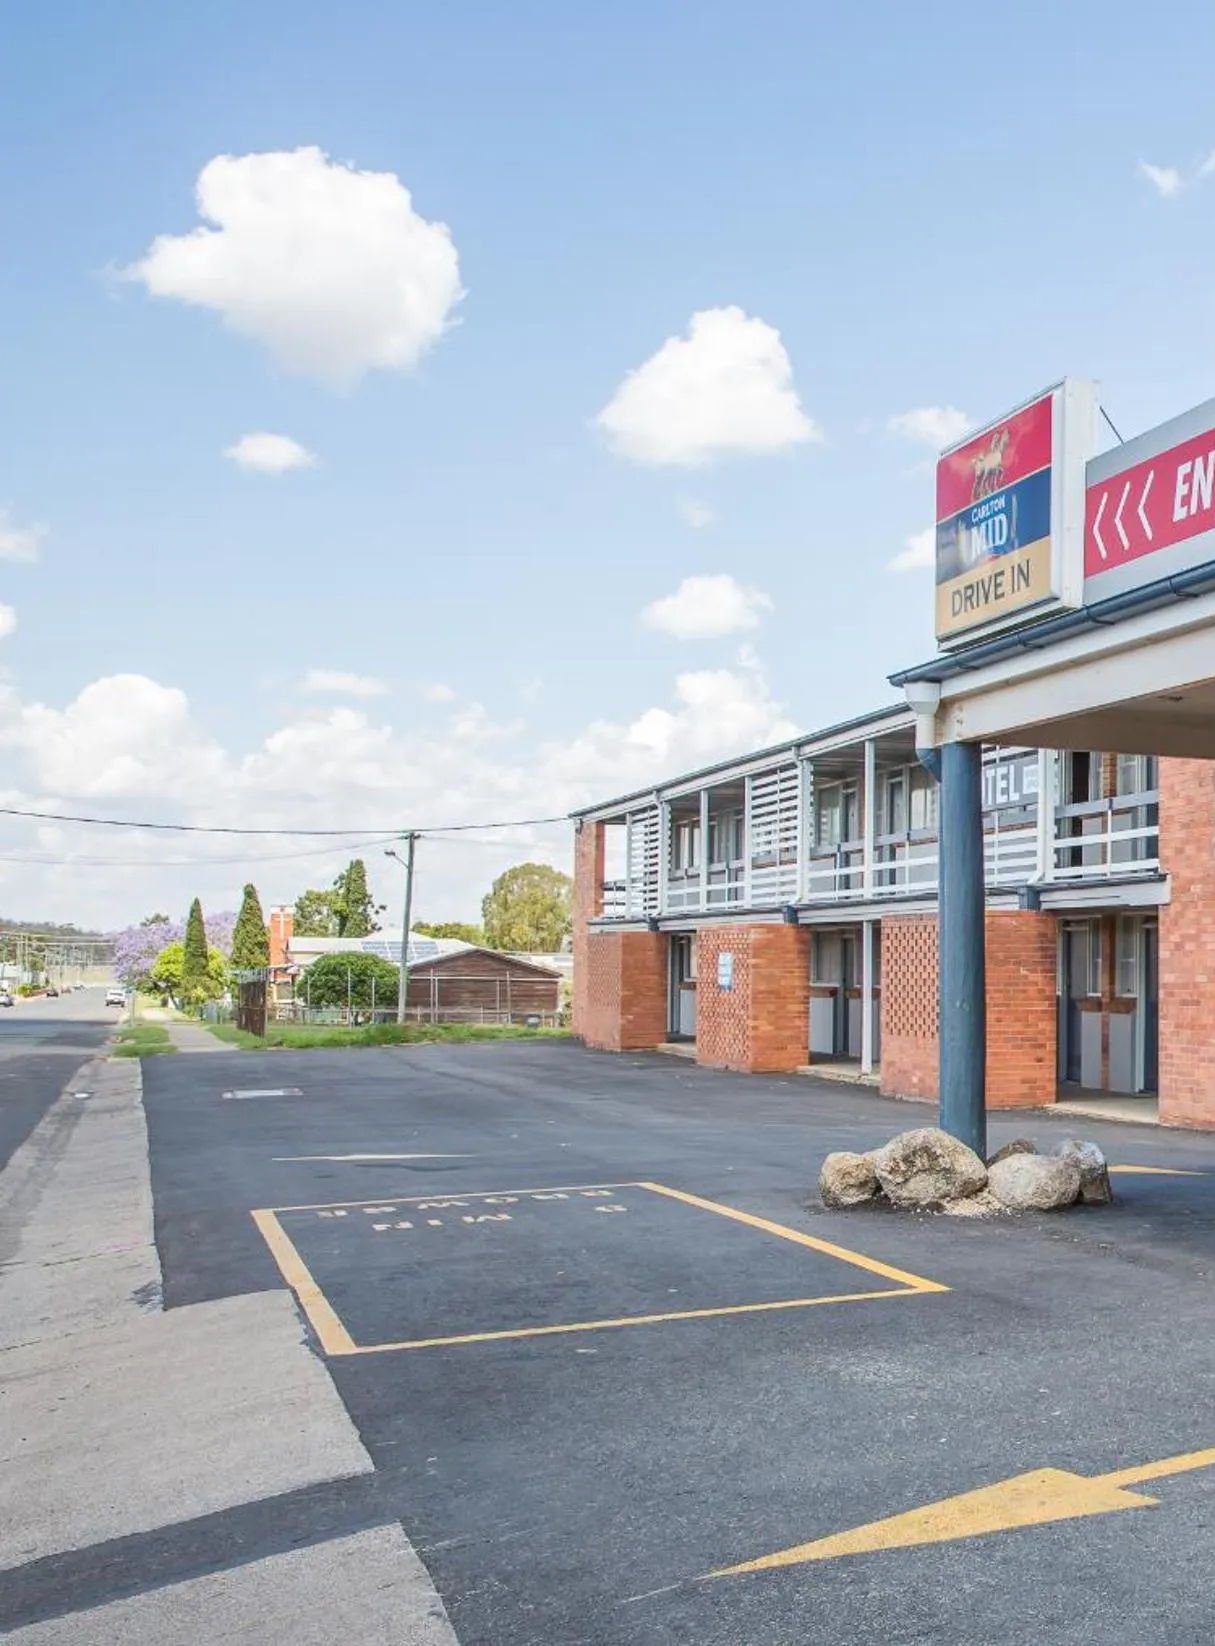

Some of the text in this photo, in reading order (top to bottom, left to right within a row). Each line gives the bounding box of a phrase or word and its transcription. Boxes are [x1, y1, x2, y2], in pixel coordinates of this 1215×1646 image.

[971, 494, 1006, 522] CARLTON
[971, 513, 1009, 557] MID
[951, 559, 1031, 618] DRIVE IN
[984, 764, 1020, 806] TEL
